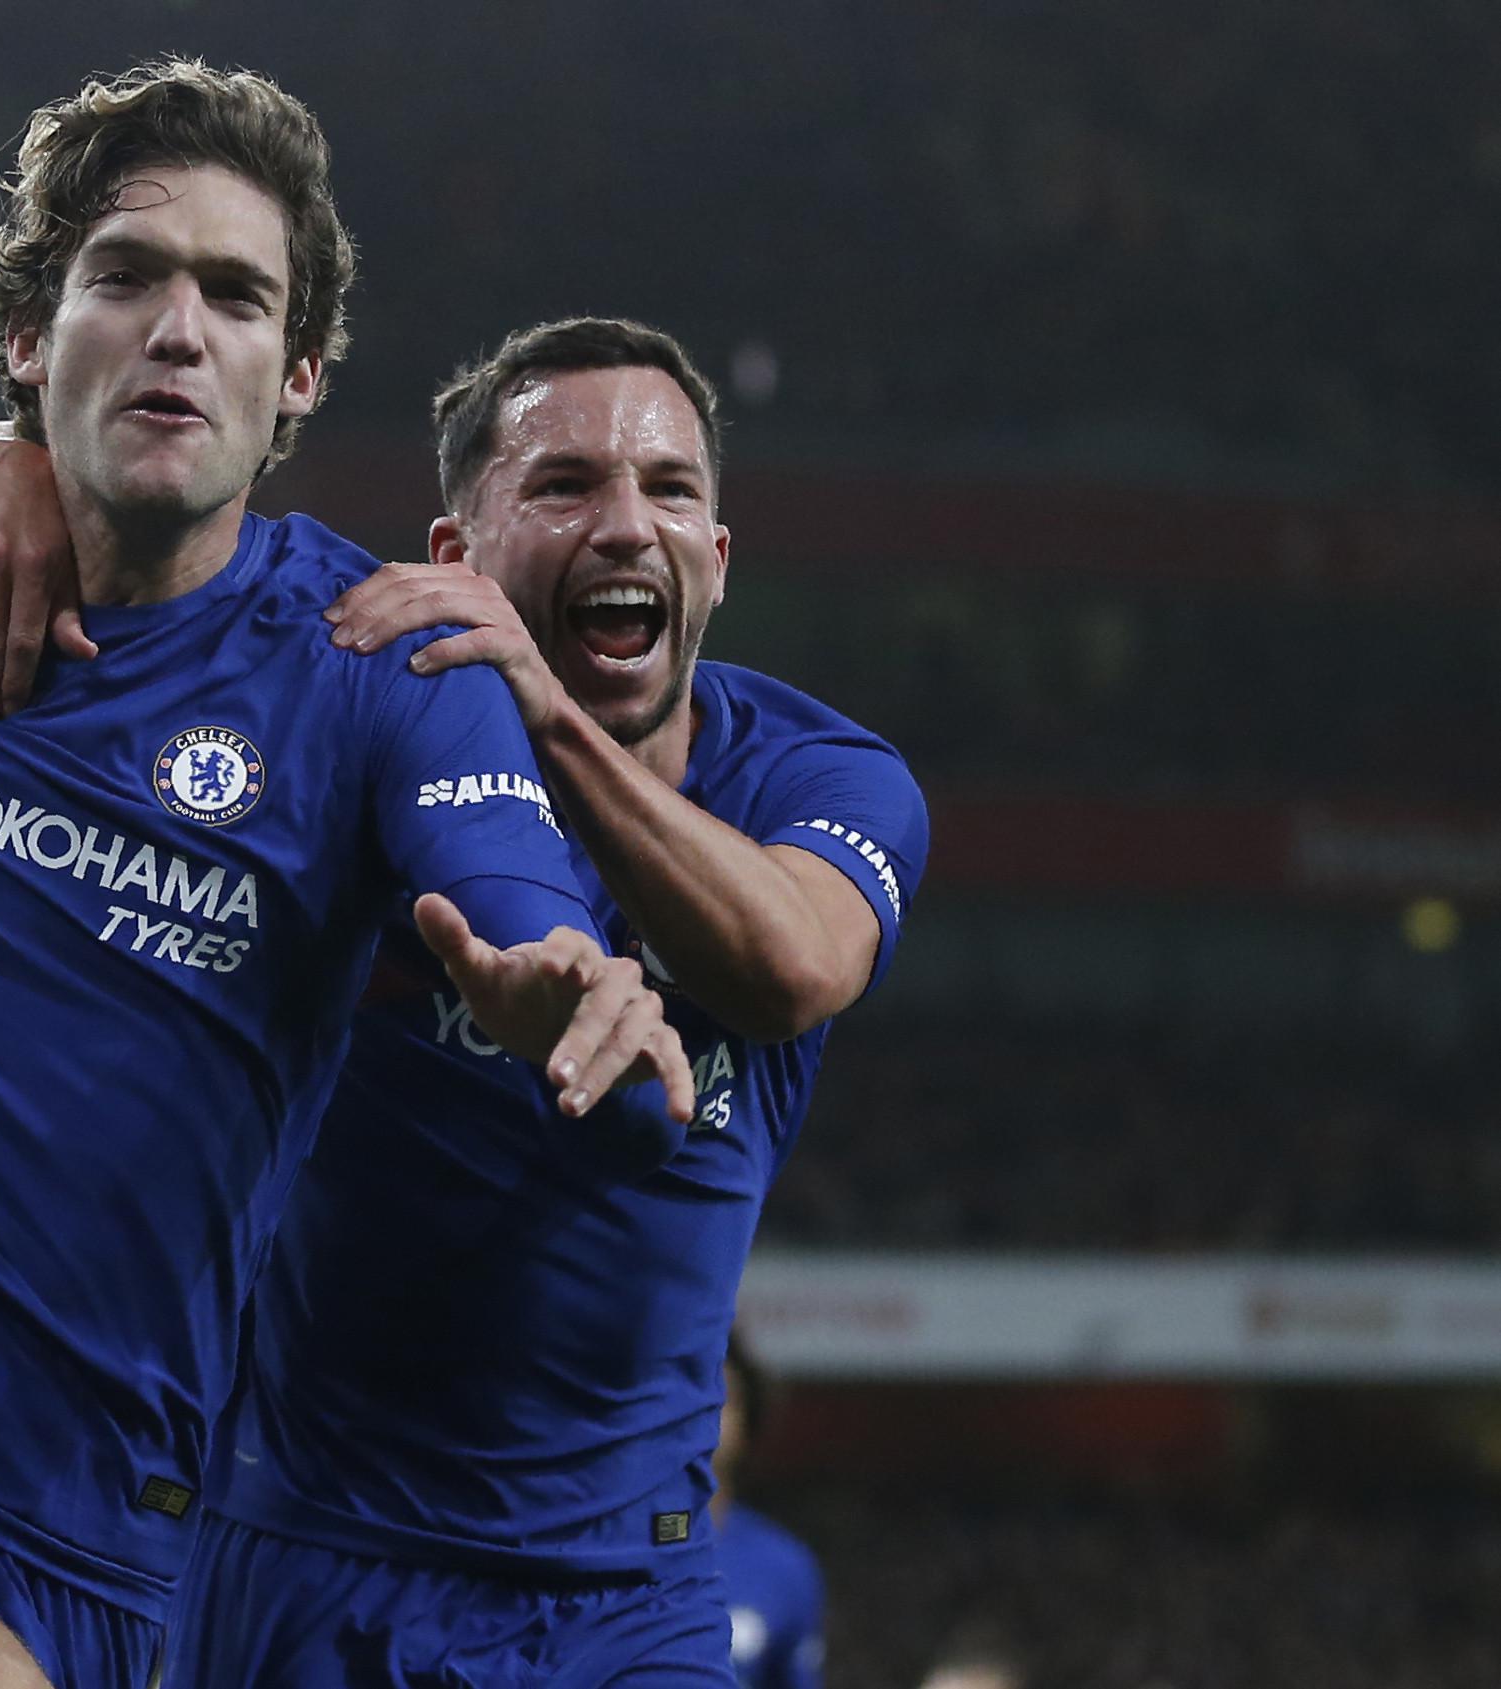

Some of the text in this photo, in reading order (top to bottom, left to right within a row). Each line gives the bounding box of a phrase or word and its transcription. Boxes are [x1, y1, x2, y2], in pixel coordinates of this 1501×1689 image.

[175, 729, 246, 754] CHELSEA
[170, 800, 244, 822] FOOTBALL CLUB
[98, 905, 250, 973] TYRES
